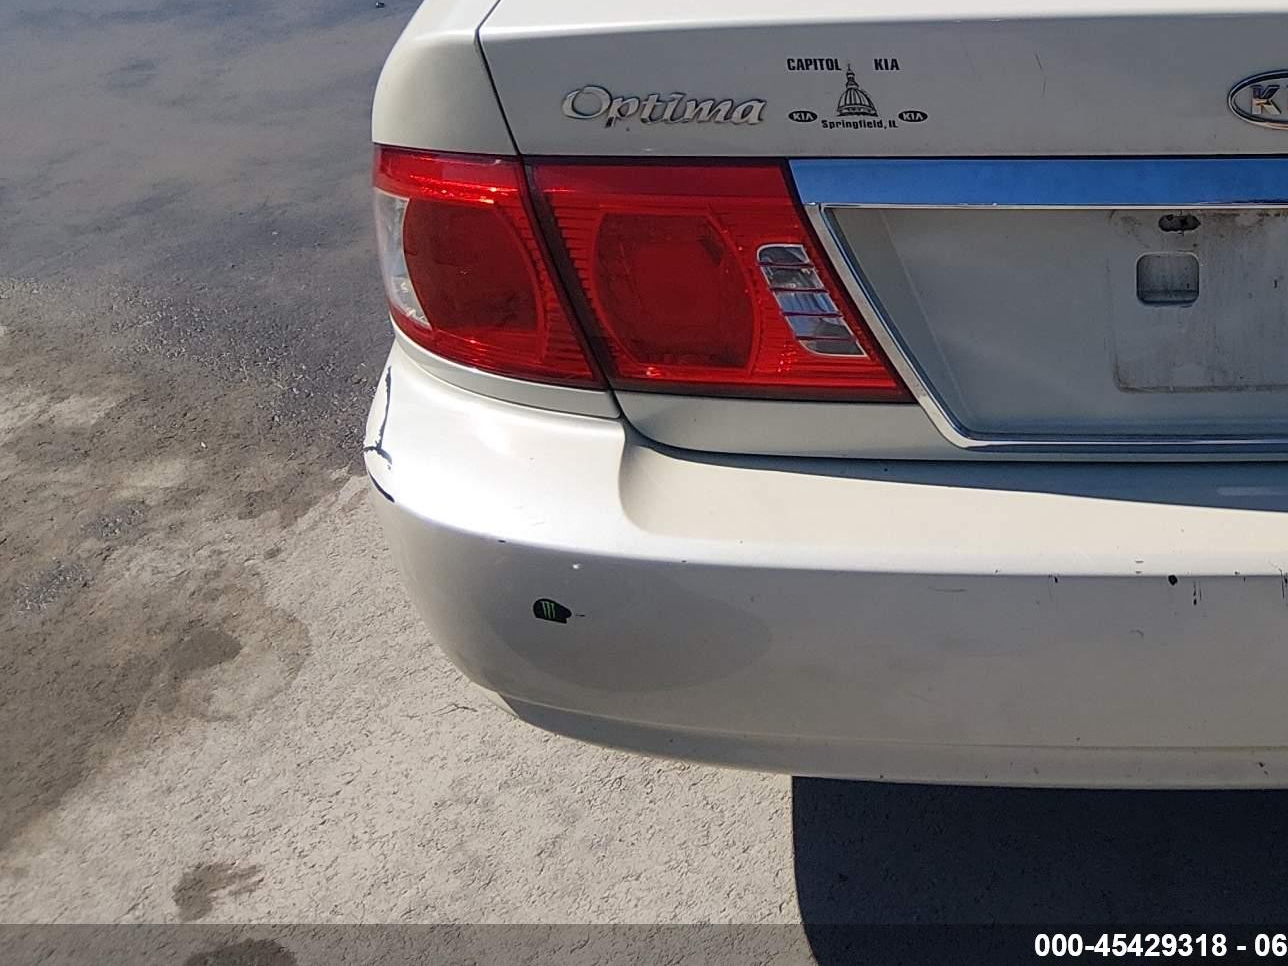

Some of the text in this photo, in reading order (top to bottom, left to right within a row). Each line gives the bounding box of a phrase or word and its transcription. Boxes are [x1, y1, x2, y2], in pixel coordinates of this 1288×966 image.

[787, 58, 900, 71] CAPITOL KIA
[561, 84, 767, 128] Optima
[888, 119, 899, 129] IL
